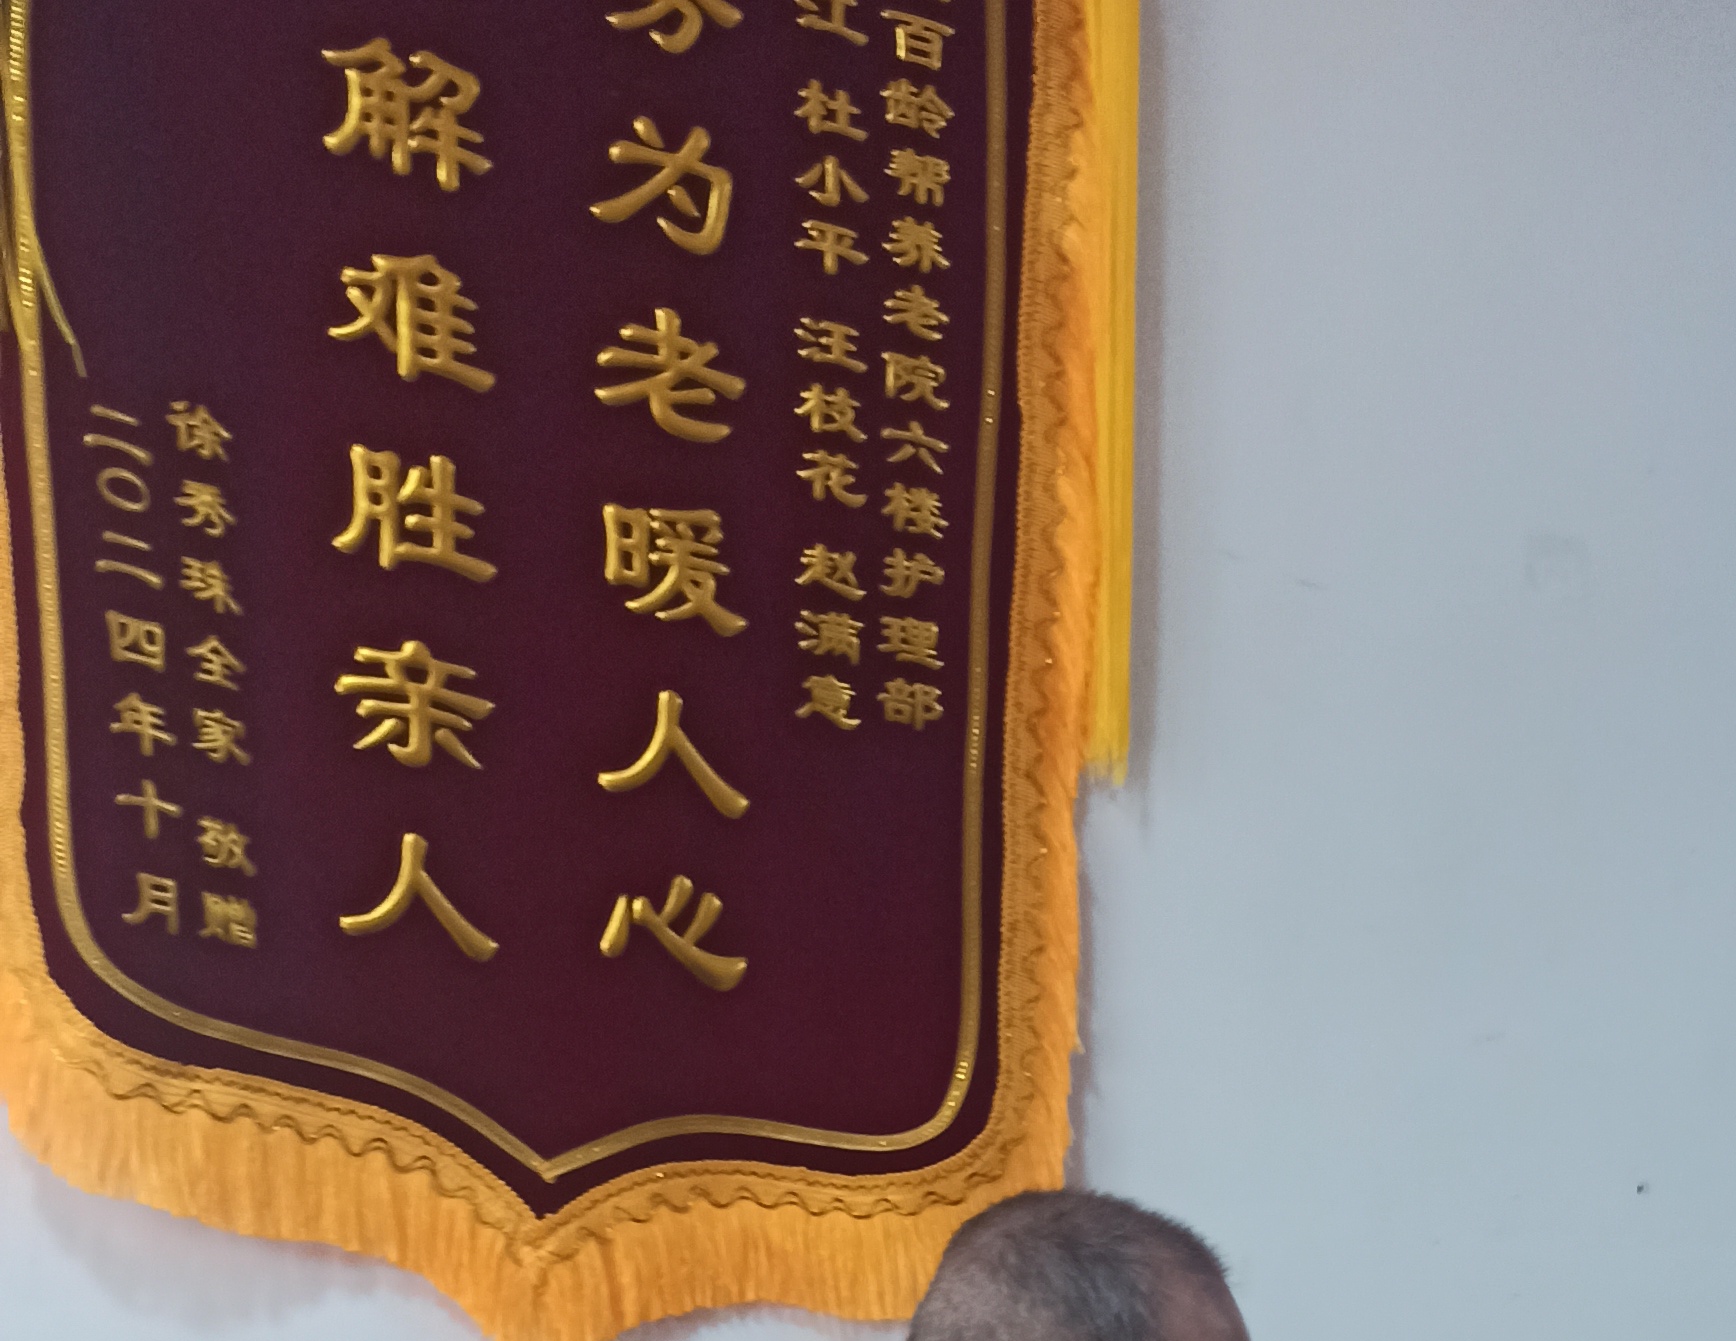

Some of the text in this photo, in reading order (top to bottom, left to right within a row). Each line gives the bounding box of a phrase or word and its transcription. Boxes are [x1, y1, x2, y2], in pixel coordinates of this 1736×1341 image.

[320, 37, 498, 961] 解难胜亲人
[877, 0, 956, 732] 百龄帮养老院六楼护理部
